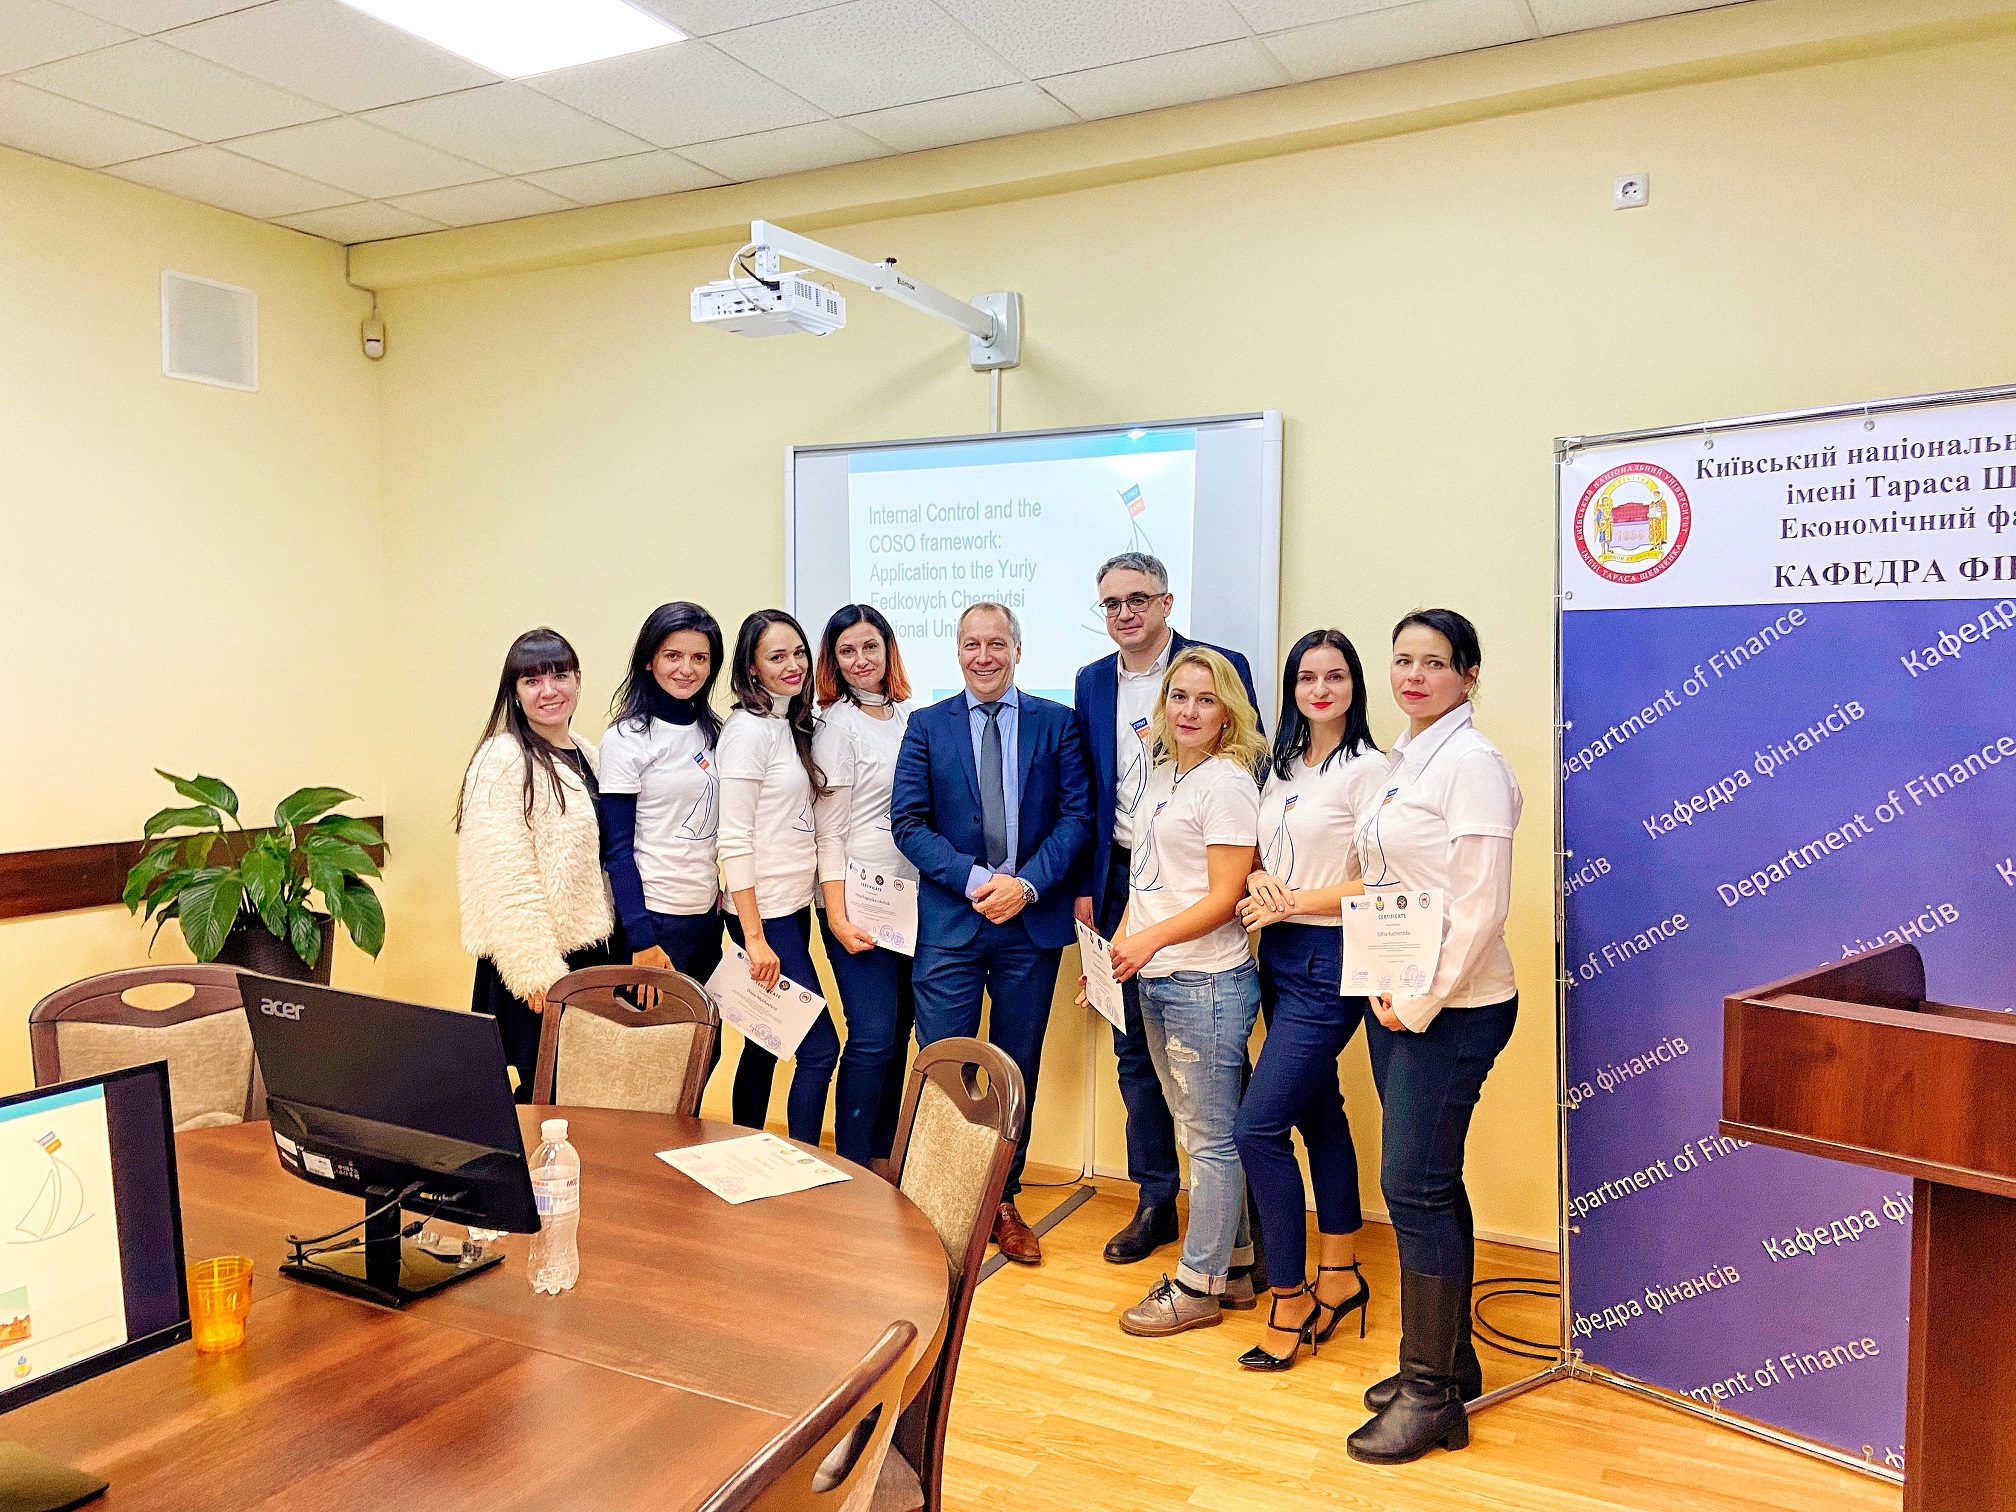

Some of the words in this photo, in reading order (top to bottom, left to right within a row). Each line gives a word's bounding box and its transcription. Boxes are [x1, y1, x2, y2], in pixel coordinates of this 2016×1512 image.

[1695, 445, 1838, 480] Київський
[1787, 478, 1856, 505] імені
[1866, 473, 1971, 502] Тараса
[869, 504, 921, 525] Internal
[926, 501, 979, 522] Control
[984, 499, 1012, 520] and
[1017, 498, 1042, 518] the
[1780, 506, 1978, 540] Економічний
[1988, 504, 2016, 534] ф
[869, 534, 916, 553] COSO
[920, 530, 1002, 552] framework:
[869, 562, 947, 586] Application
[952, 562, 965, 580] to
[970, 560, 993, 580] the
[998, 559, 1037, 582] Yuriy
[1773, 558, 1946, 589] КАФЕДРА
[870, 590, 947, 614] Fedkovych
[1682, 664, 1709, 697] of
[1708, 607, 1807, 678] Finance
[1900, 600, 2016, 678] Кафедр
[1642, 769, 1752, 840] Кафедра
[1754, 701, 1865, 777] фінансів
[1716, 814, 1873, 907] Department
[1875, 790, 1905, 824] of
[1904, 735, 2016, 807] Finance
[1579, 952, 1602, 980] of
[1601, 913, 1689, 968] Finance
[260, 998, 305, 1021] acer
[1567, 1081, 1595, 1110] ра
[1597, 1037, 1689, 1093] фінансів
[1673, 1144, 1698, 1173] of
[1762, 1208, 1880, 1262] Кафедра
[1882, 1191, 1913, 1225] фі
[1644, 1264, 1740, 1314] фінансів
[1680, 1372, 1753, 1403] ment
[1754, 1359, 1780, 1387] of
[1780, 1337, 1880, 1379] Finance
